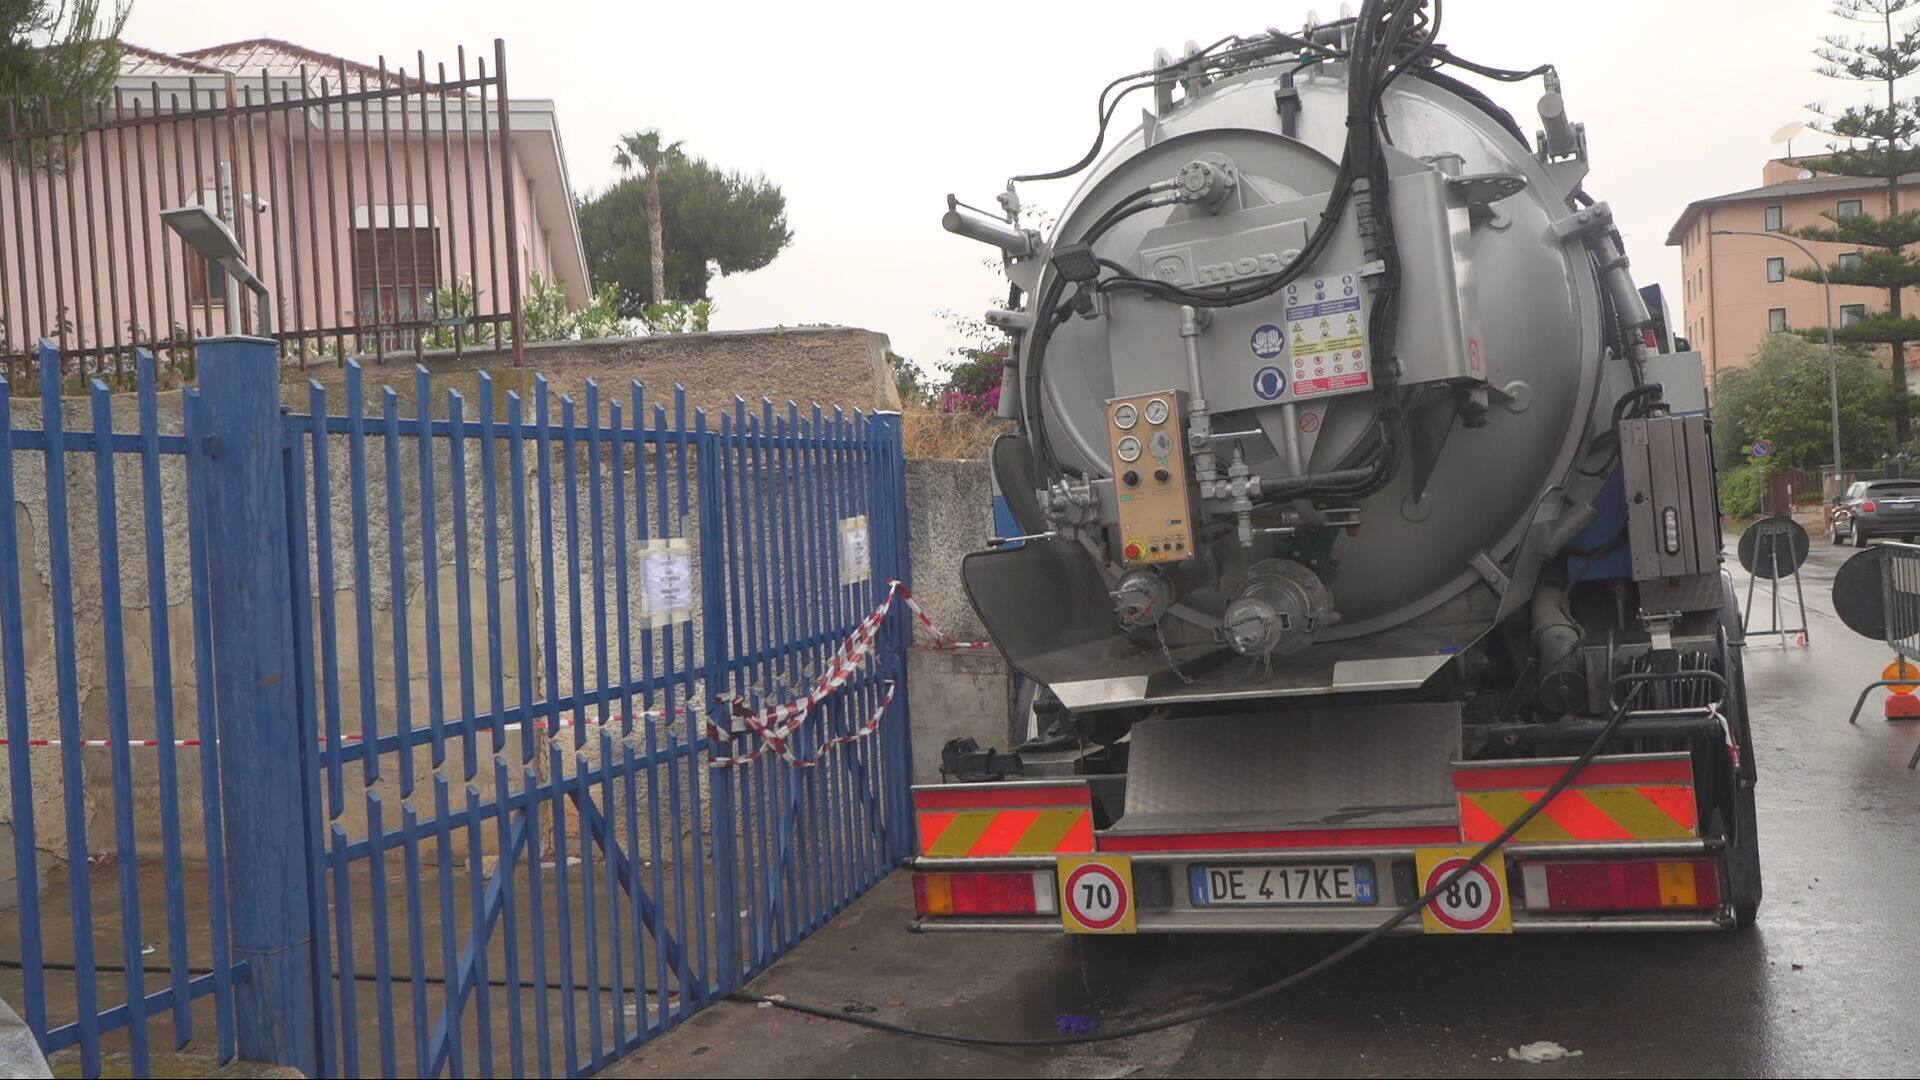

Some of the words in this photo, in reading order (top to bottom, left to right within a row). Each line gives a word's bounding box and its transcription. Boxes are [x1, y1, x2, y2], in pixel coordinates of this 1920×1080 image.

[1082, 884, 1112, 909] 70
[1211, 870, 1246, 900] DE
[1258, 868, 1352, 899] 417KE
[1356, 883, 1370, 897] CN
[1446, 880, 1482, 909] 80
